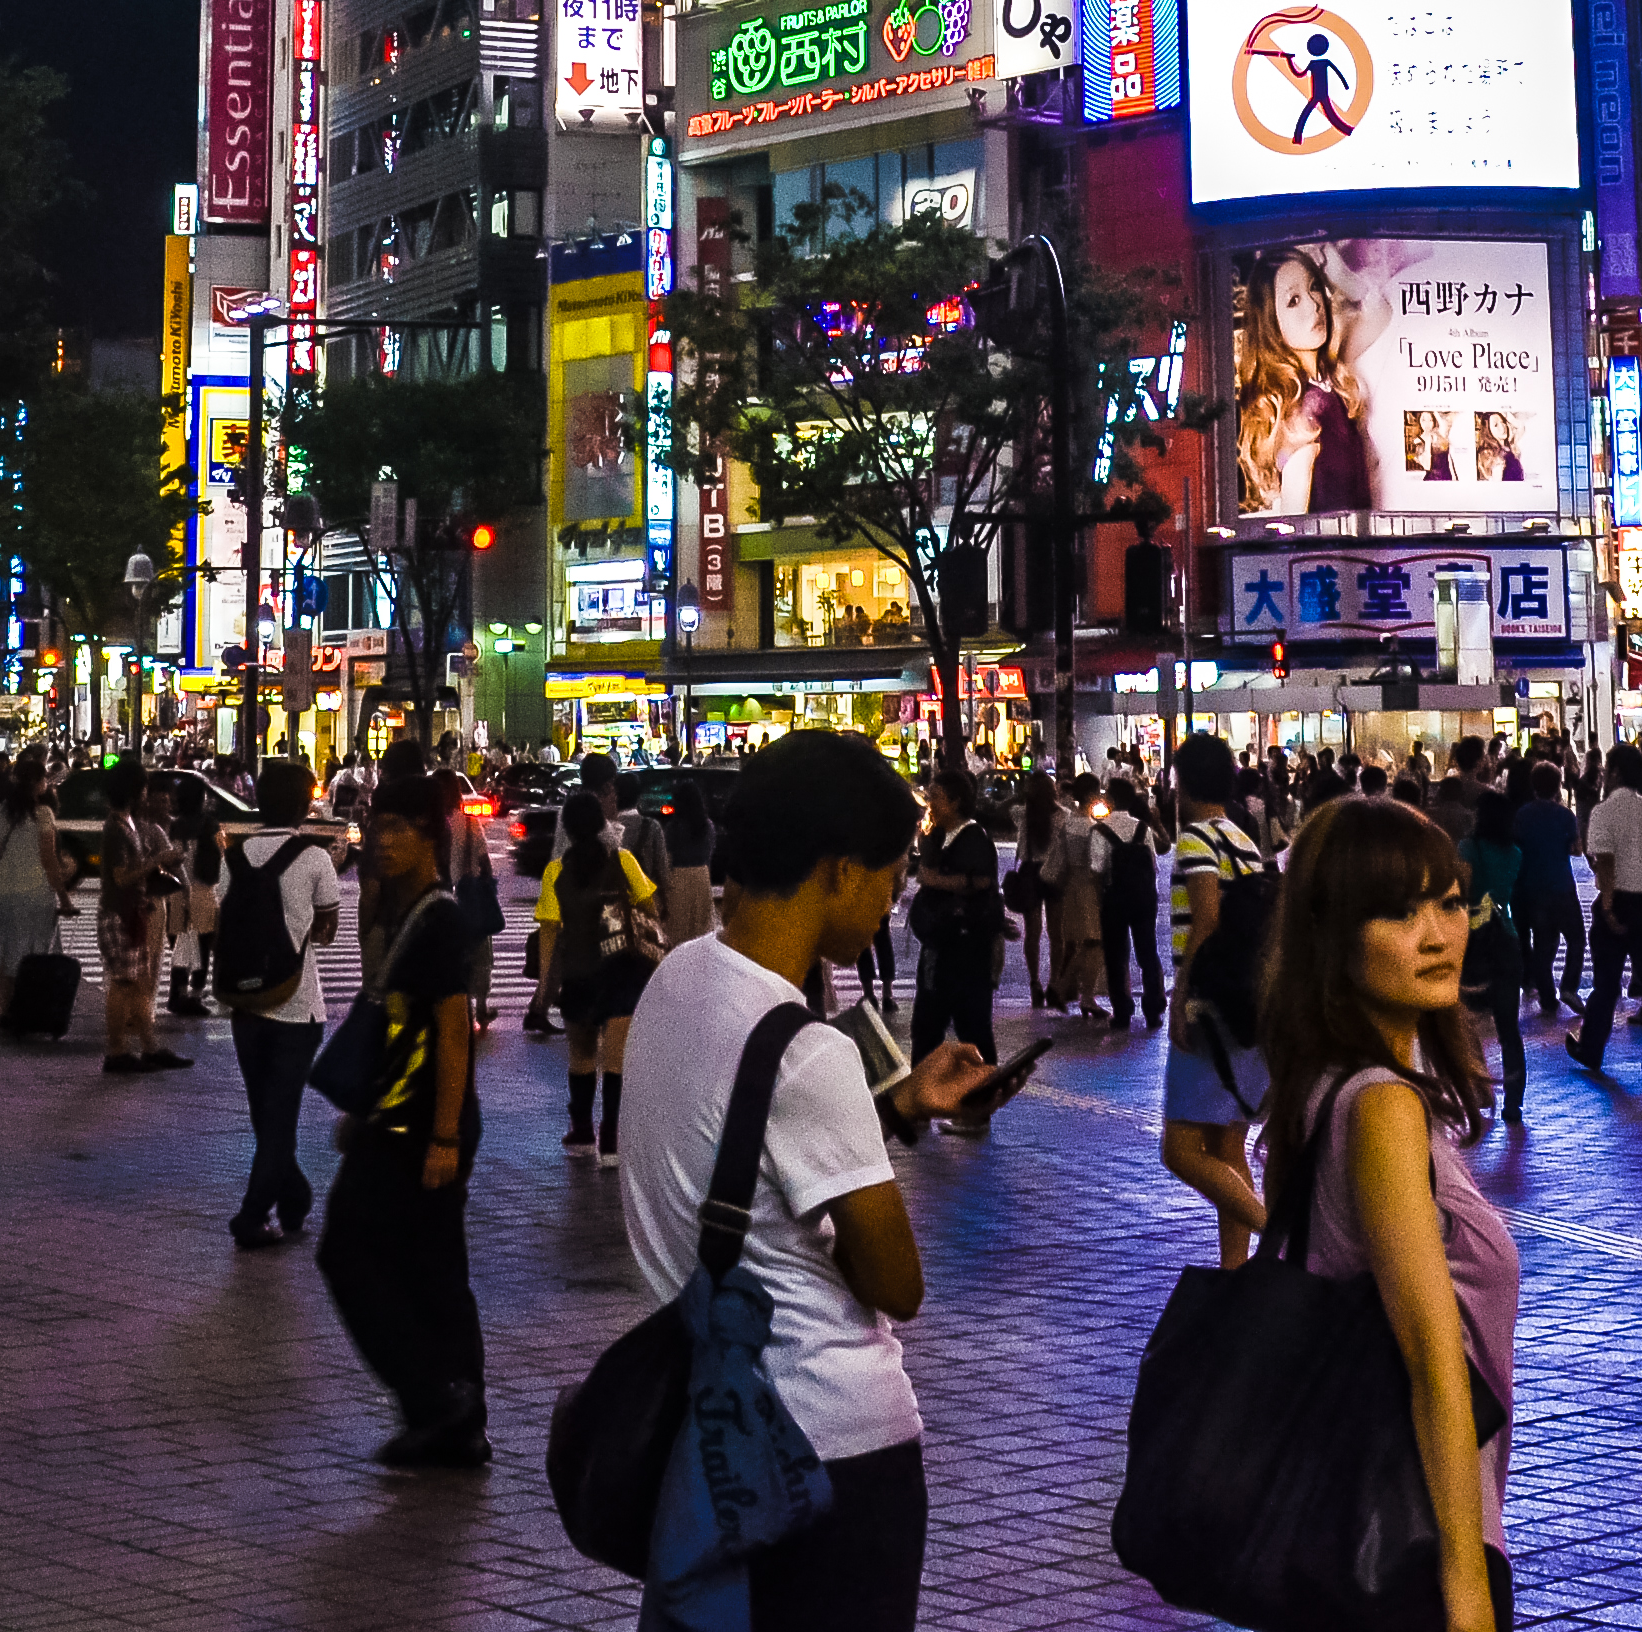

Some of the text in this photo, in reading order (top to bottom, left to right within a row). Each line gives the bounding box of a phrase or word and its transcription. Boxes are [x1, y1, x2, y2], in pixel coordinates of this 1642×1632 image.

[577, 25, 623, 51] まで
[780, 22, 868, 87] 西村
[599, 67, 639, 96] 地下
[1399, 280, 1535, 318] 西野カナ
[1245, 562, 1550, 626] 大盛堂店
